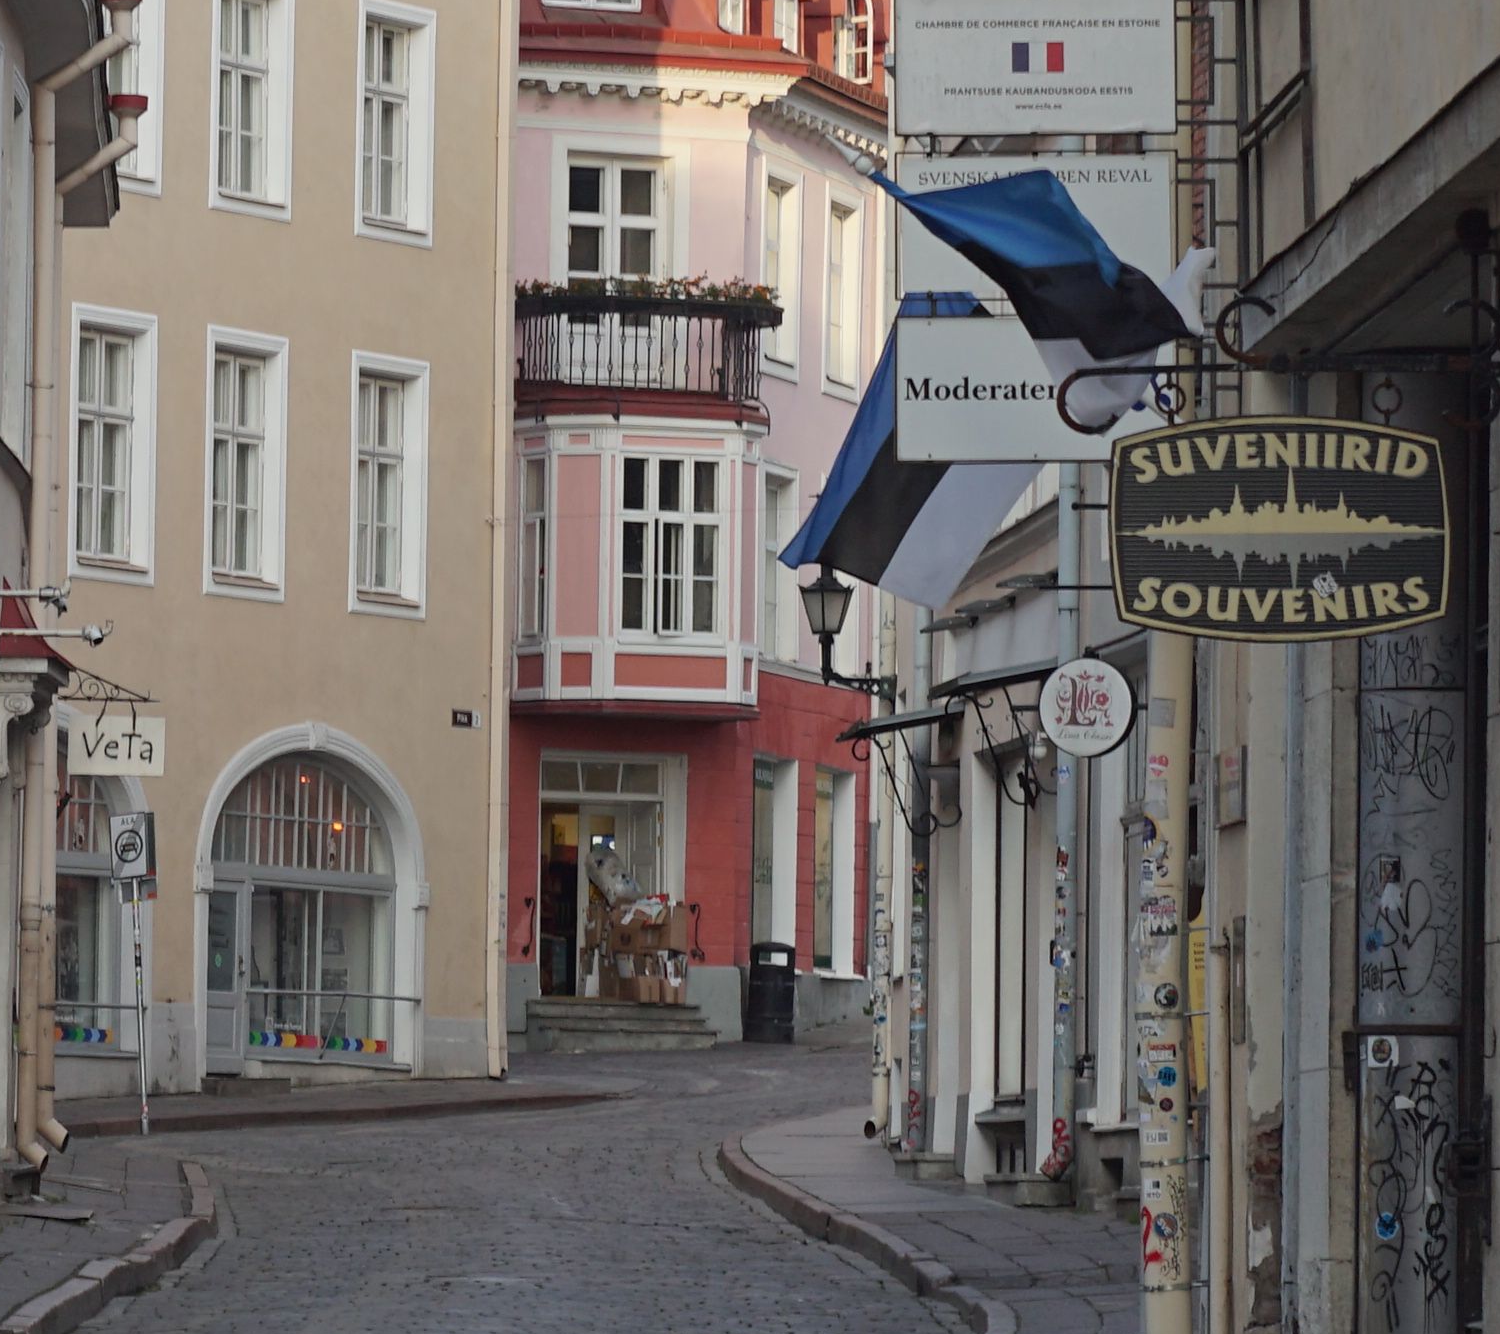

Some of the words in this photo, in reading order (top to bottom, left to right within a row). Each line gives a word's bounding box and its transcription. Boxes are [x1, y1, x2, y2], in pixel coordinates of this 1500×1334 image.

[915, 20, 964, 30] CHAMBRE
[967, 20, 980, 29] DE
[983, 20, 1039, 29] COMMERCE
[1042, 20, 1100, 31] FRANÇAISE
[1102, 20, 1115, 28] EN
[1118, 19, 1161, 28] ESTONIE
[944, 87, 1002, 96] PRANTSUSE
[1005, 87, 1097, 96] KAUBANDUSKODA
[1100, 86, 1134, 95] EESTIS
[1097, 169, 1152, 183] REVAL
[1130, 433, 1430, 483] SUVENIIRID
[1133, 577, 1430, 623] SOUVENIRS
[82, 731, 153, 764] VeTa
